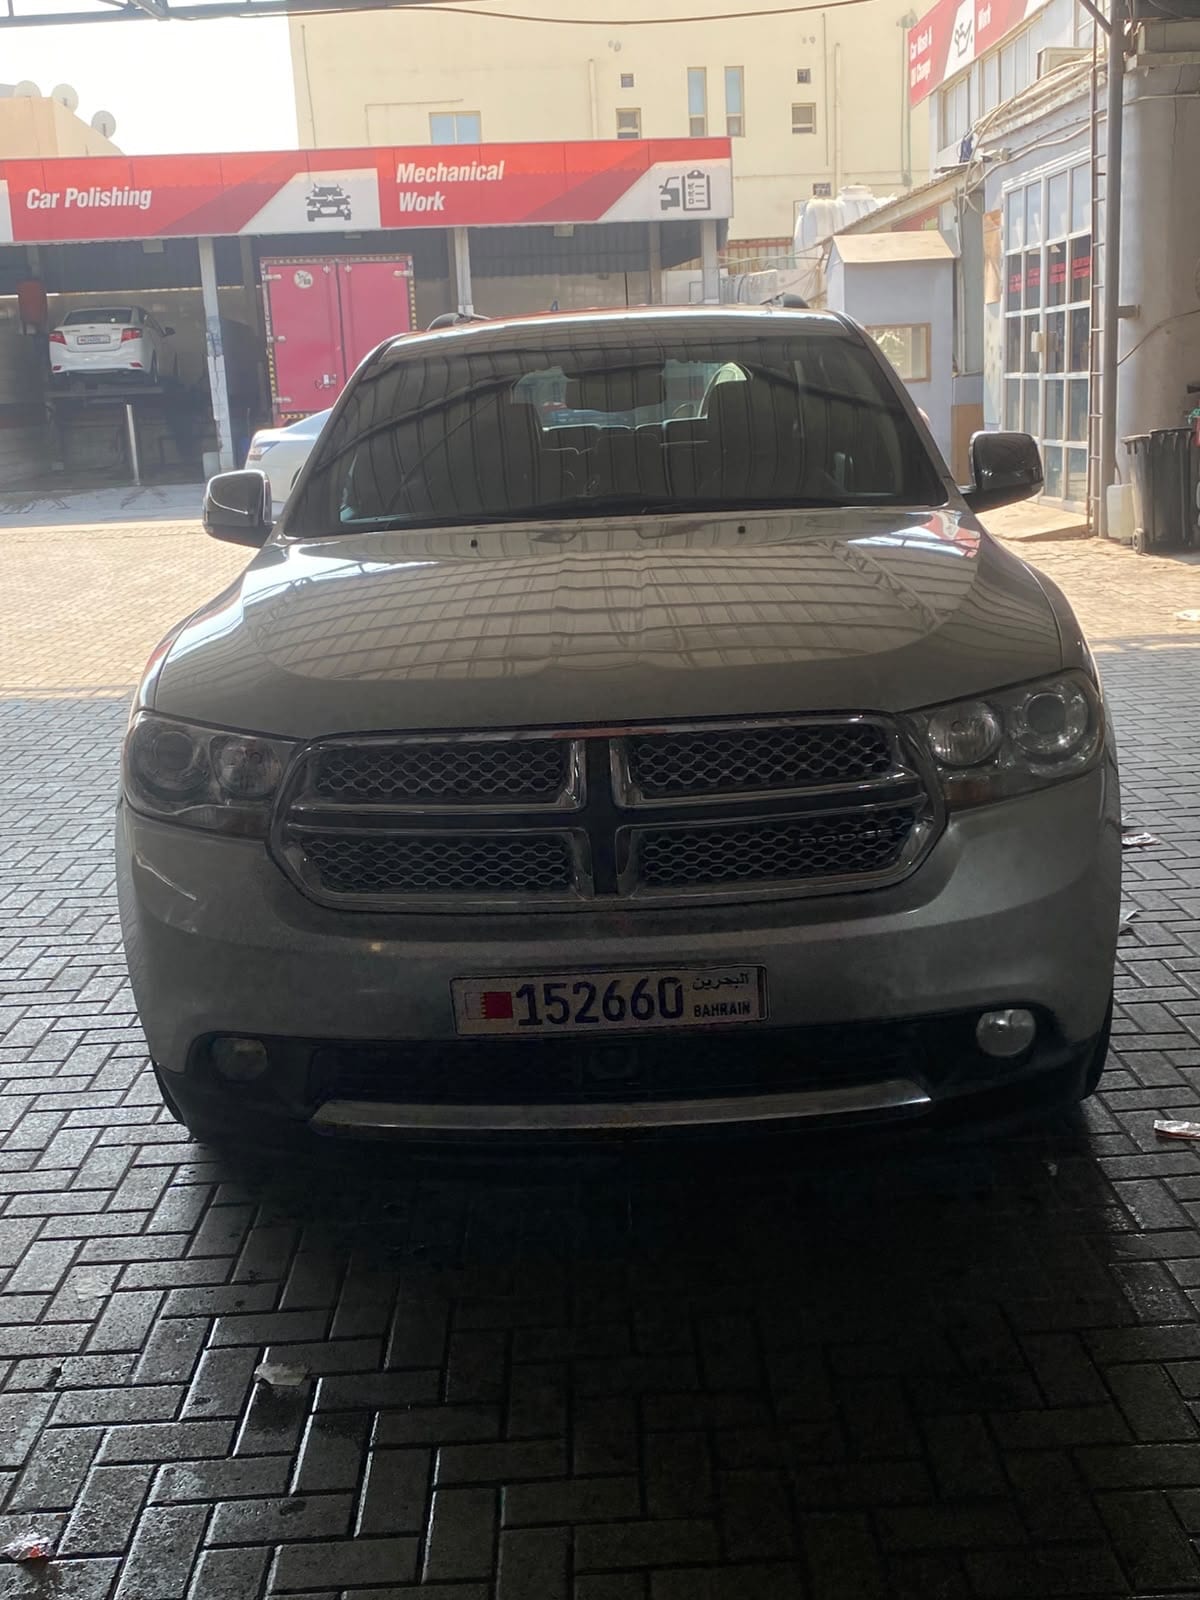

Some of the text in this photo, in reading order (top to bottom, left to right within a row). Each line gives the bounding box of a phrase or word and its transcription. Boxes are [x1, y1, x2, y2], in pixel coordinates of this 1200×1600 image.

[396, 160, 505, 183] Mechanical
[26, 186, 152, 210] Car Polishing
[399, 191, 446, 212] Work
[692, 972, 749, 991] البحرين
[515, 976, 684, 1026] 152660
[693, 1001, 751, 1018] BAHRAIN
